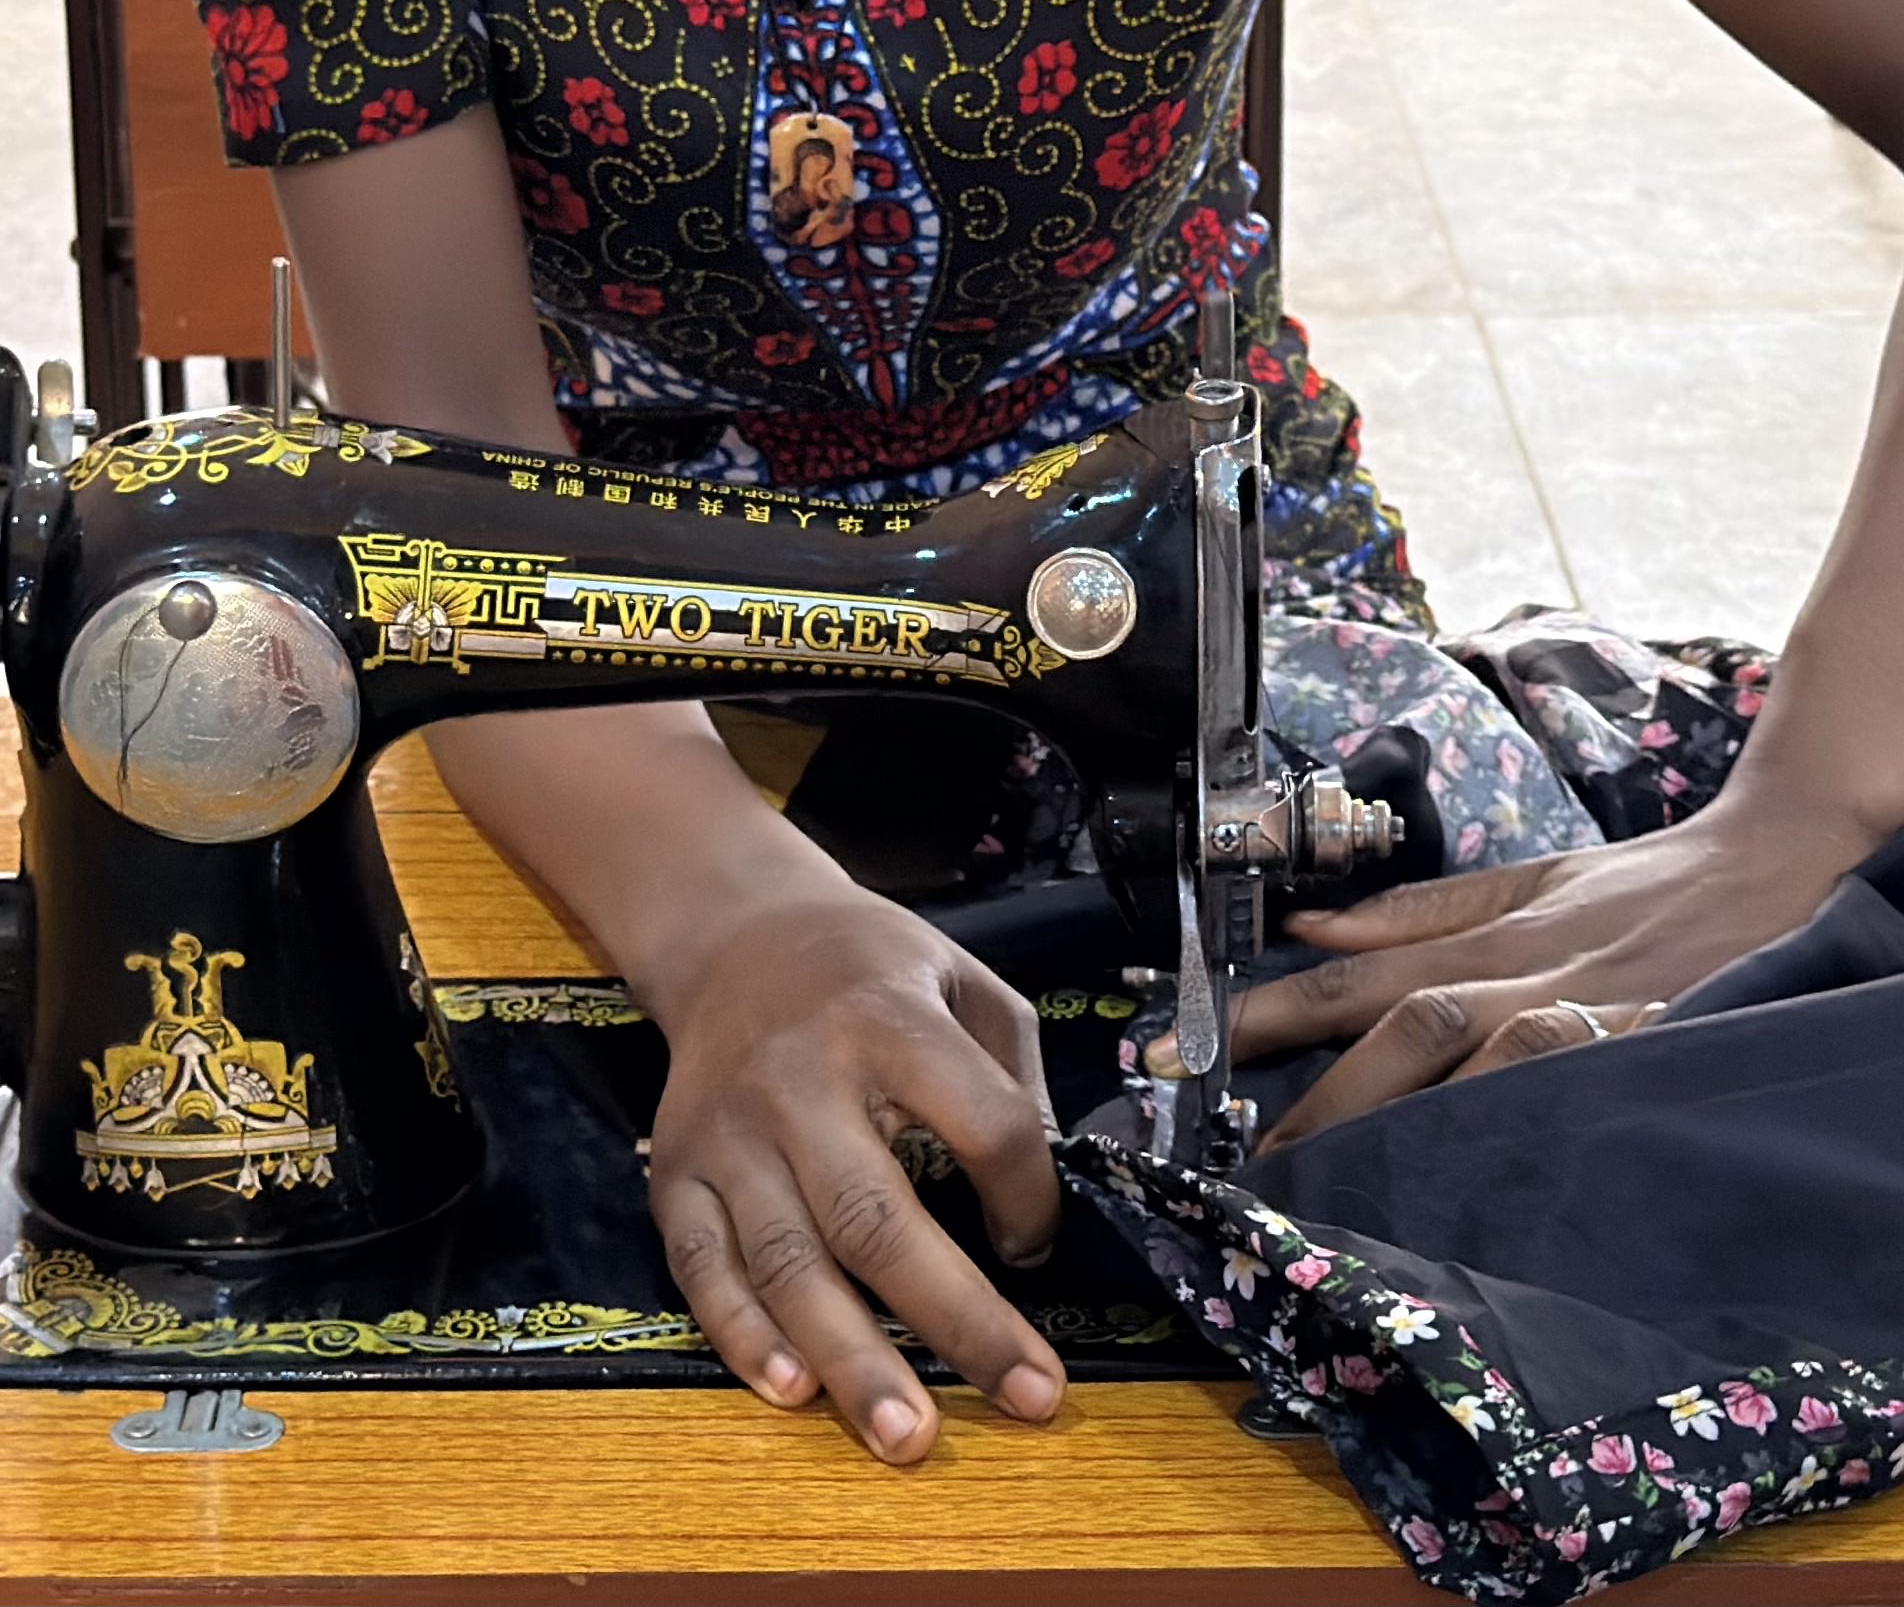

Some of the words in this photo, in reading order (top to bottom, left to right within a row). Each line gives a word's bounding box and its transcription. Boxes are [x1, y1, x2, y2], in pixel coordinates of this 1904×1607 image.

[480, 450, 547, 469] CHINA
[553, 462, 582, 474] OF
[587, 465, 693, 490] REPUBLIC
[508, 469, 911, 534] 中华人民共和国制造
[699, 481, 801, 504] PEOPLE'S
[808, 497, 848, 510] THE
[854, 503, 875, 511] IN
[881, 497, 941, 512] MADE
[572, 587, 712, 643] TWO
[737, 598, 933, 659] TIGER
